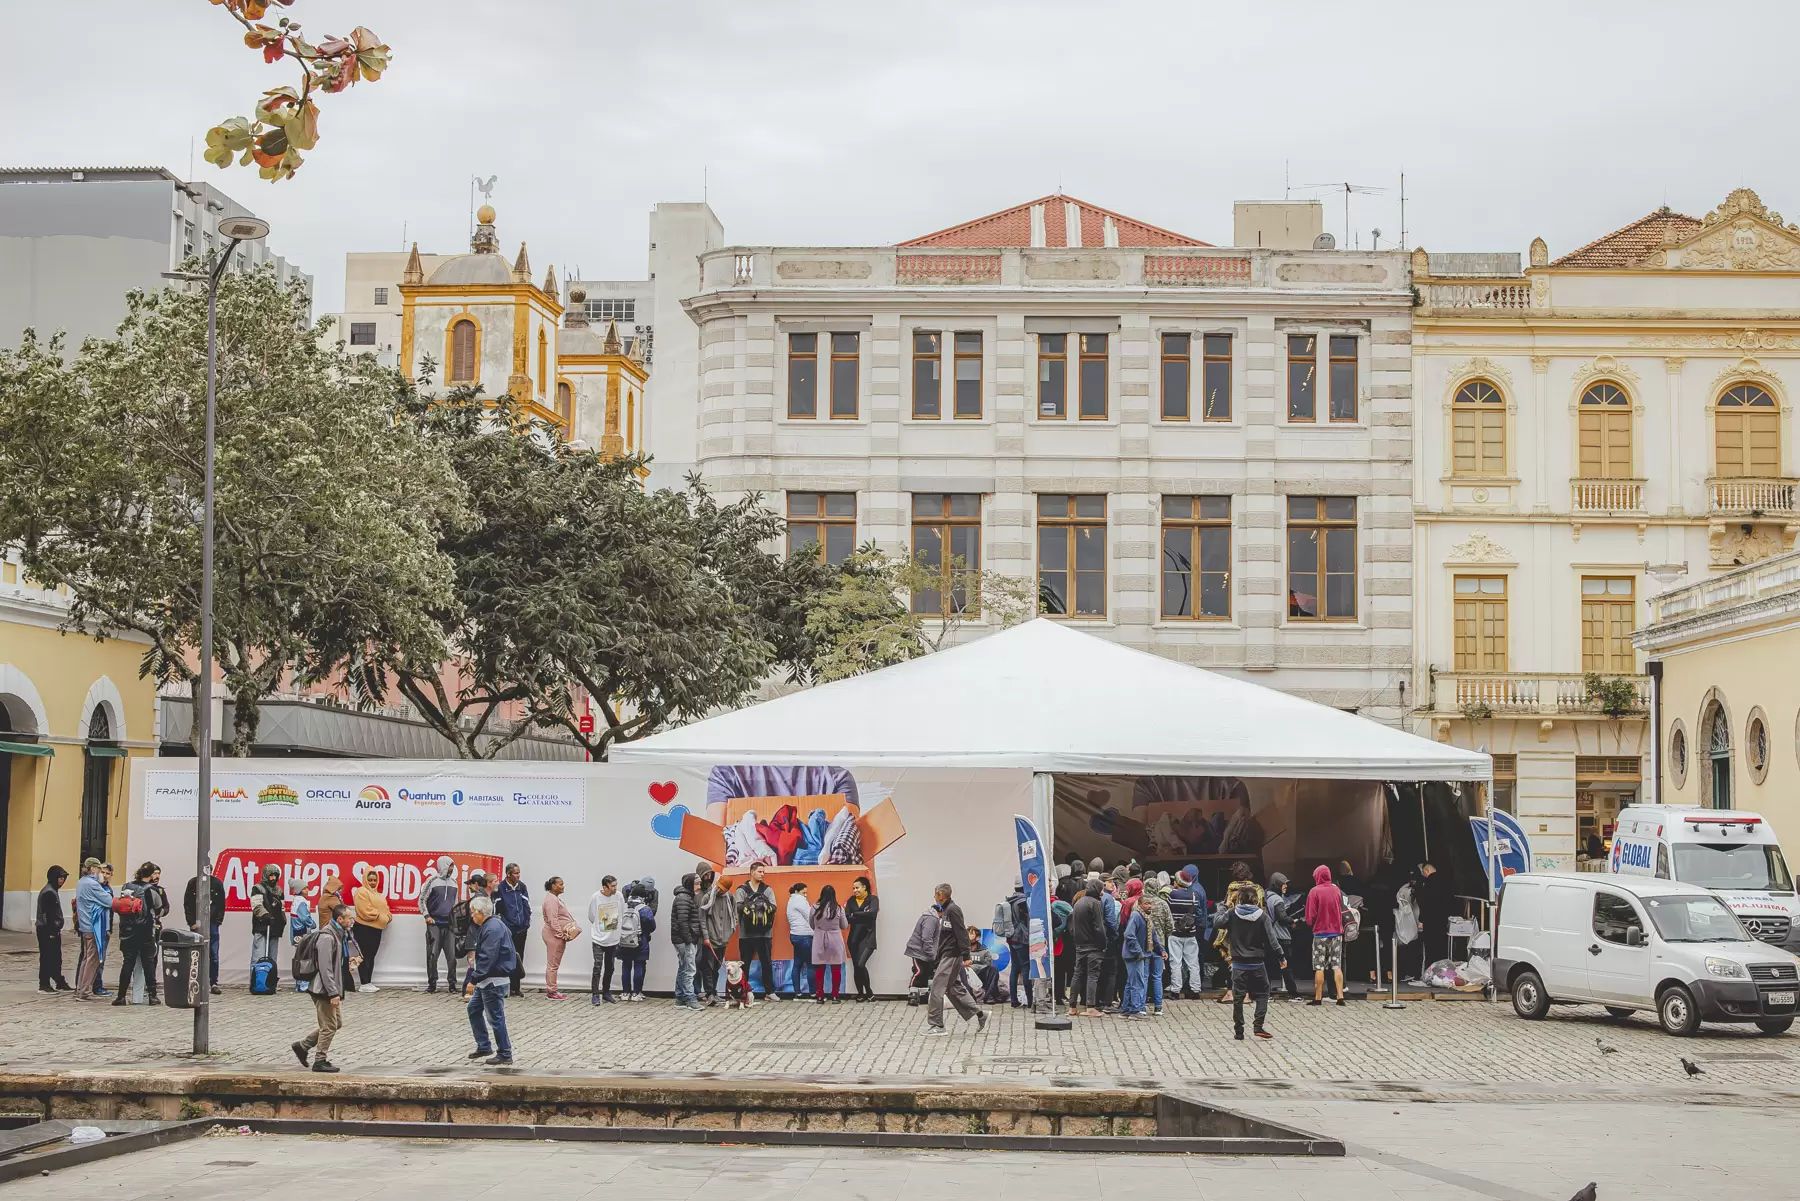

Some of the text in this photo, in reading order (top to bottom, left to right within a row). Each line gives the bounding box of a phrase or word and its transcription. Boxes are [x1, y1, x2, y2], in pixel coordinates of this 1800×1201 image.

[306, 790, 351, 799] ORCALI
[398, 788, 446, 801] Quantum
[355, 800, 391, 809] Aurora
[1621, 842, 1652, 868] GLOBAL
